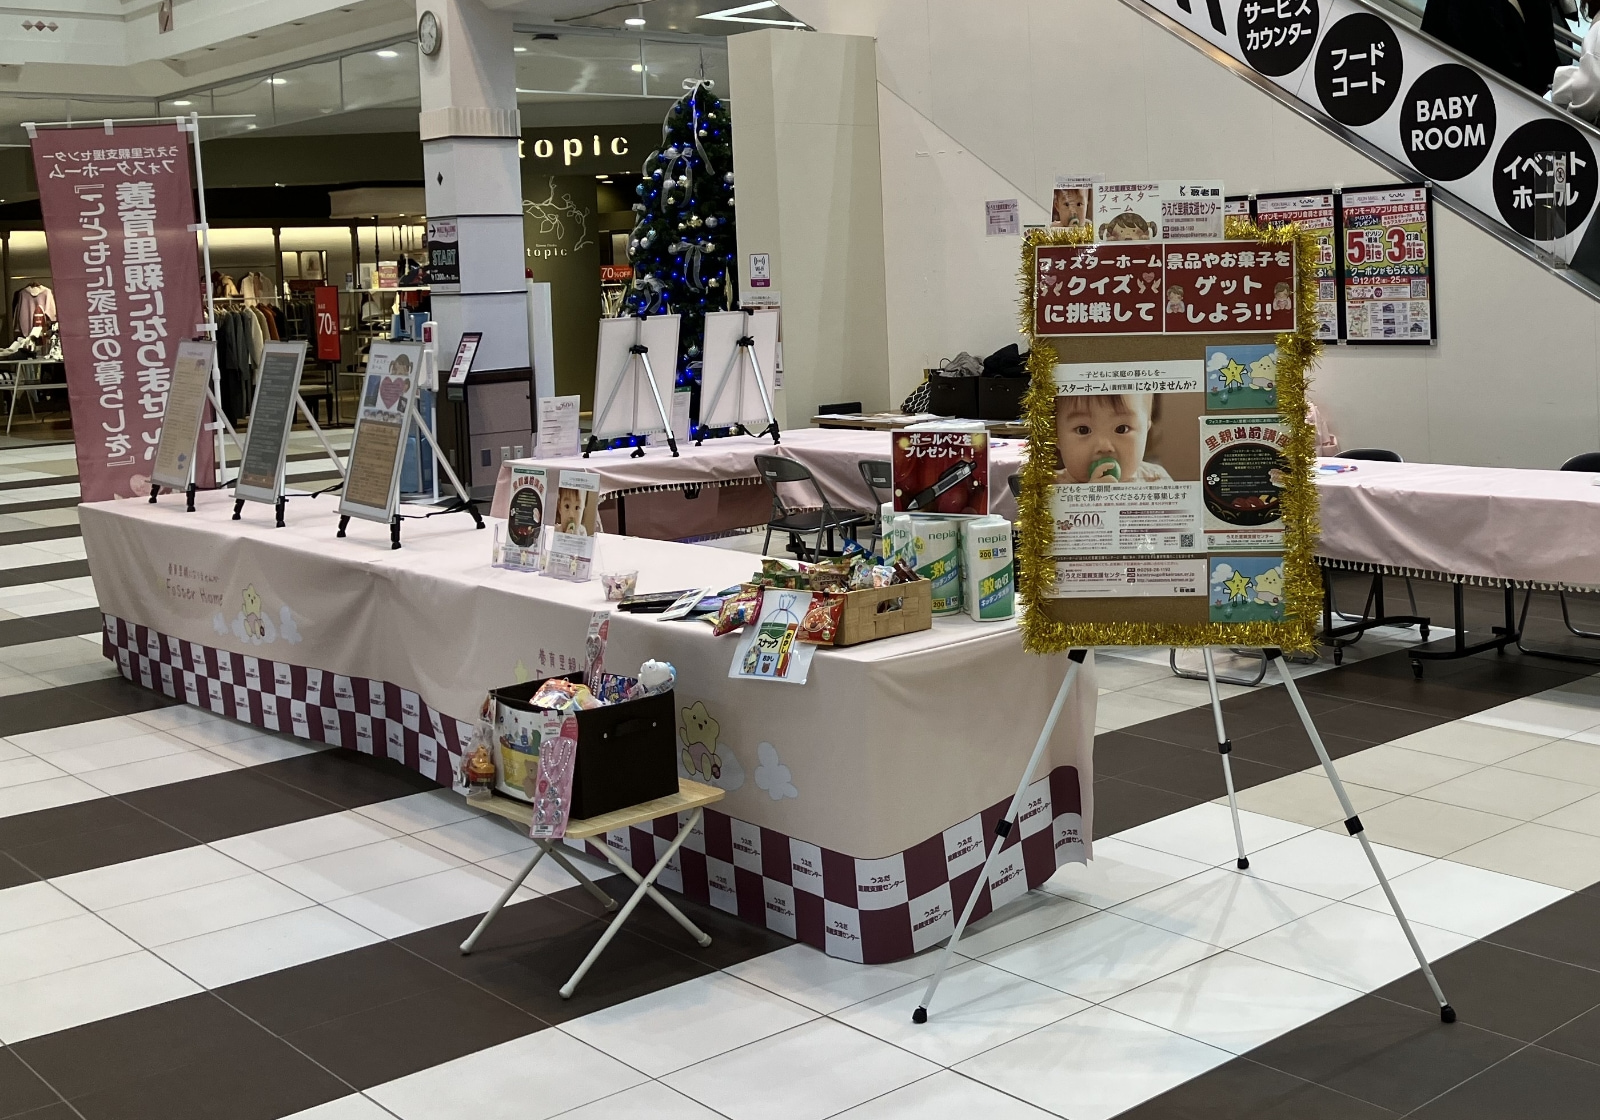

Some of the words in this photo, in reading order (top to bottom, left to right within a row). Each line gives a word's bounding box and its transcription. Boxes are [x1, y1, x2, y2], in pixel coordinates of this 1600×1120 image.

[1244, 0, 1312, 24] サービス
[1246, 22, 1312, 51] カウンター
[1330, 41, 1386, 71] フード
[1331, 72, 1386, 98] コート
[1416, 94, 1478, 122] BABY
[1411, 123, 1486, 151] ROOM
[518, 135, 629, 166] topic
[1099, 184, 1159, 193] うえだ里親支援センター
[1512, 182, 1579, 209] ホール
[1099, 192, 1160, 203] フォスター
[1098, 205, 1134, 213] ホーム
[1162, 201, 1221, 217] うえだ里親支援センター
[526, 247, 568, 260] topic
[1347, 231, 1365, 263] 5
[1387, 229, 1406, 262] 3
[1406, 247, 1424, 259] 引き
[432, 249, 457, 266] START
[1166, 250, 1291, 270] 景品やお菓子を
[1366, 249, 1382, 259] 引き
[1038, 254, 1163, 271] フォスターホーム
[1351, 265, 1419, 276] クーポンがもらえる!
[1067, 274, 1134, 296] クイズ
[1195, 275, 1263, 296] ゲット
[1044, 301, 1156, 323] に挑戦して
[1186, 302, 1272, 324] しよう!!
[318, 312, 332, 335] 70
[909, 433, 972, 446] ボールペンを
[904, 446, 975, 459] プレゼント!!
[1056, 485, 1111, 494] 子どもを一定期間
[1060, 492, 1188, 502] ご自宅で預かってくださる方を募集します
[928, 529, 957, 540] nepia
[977, 533, 1008, 544] nepia
[757, 638, 779, 649] スナック
[858, 879, 905, 893] 里親支援センター
[870, 874, 891, 884] うえだ
[923, 905, 941, 918] うえだ
[833, 920, 849, 931] うえだ
[913, 909, 952, 932] 里親支援センター
[825, 926, 861, 941] 里親支援センター
